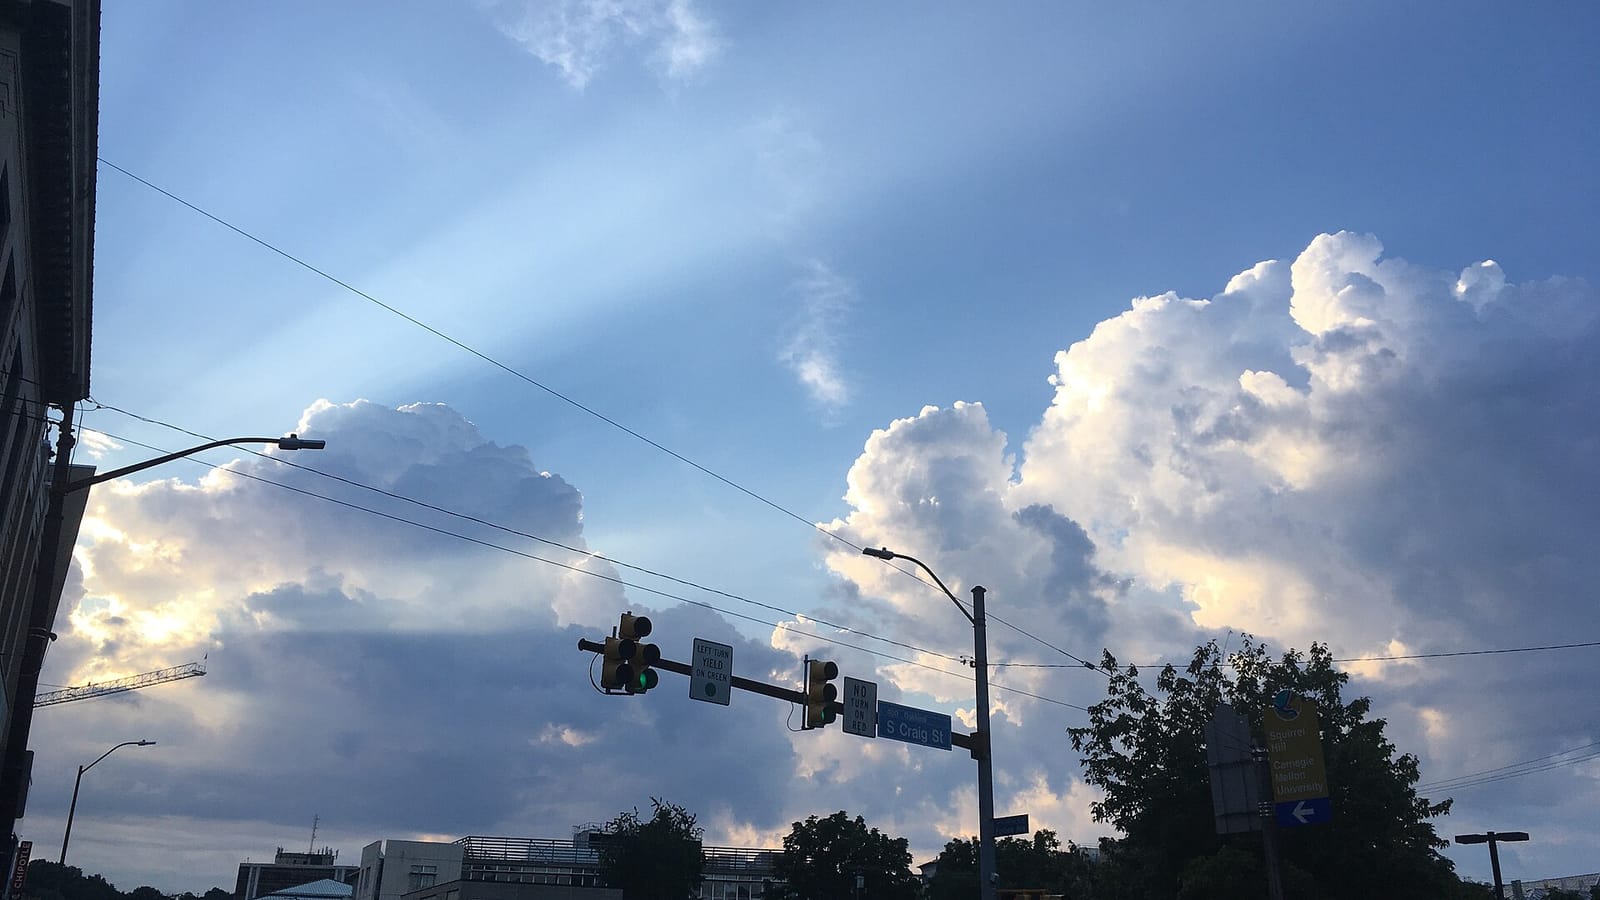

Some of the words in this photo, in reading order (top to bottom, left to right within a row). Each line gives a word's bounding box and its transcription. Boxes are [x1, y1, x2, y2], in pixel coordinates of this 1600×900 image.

[697, 644, 712, 656] LEFT
[714, 648, 729, 659] TURN
[703, 657, 723, 670] YIELD
[696, 669, 705, 678] ON
[708, 671, 728, 682] GREEN
[853, 684, 867, 697] NO
[850, 697, 869, 711] TURN
[854, 710, 865, 721] ON
[852, 720, 867, 732] RED
[886, 719, 895, 734] S
[899, 722, 928, 743] Craig
[931, 728, 944, 744] St
[1270, 728, 1305, 742] Squirrel
[1271, 741, 1288, 752] Hill
[1273, 757, 1314, 769] Carnegie
[1275, 771, 1306, 782] Mellon
[1277, 782, 1324, 795] University
[14, 842, 31, 889] CHIPOTLE
